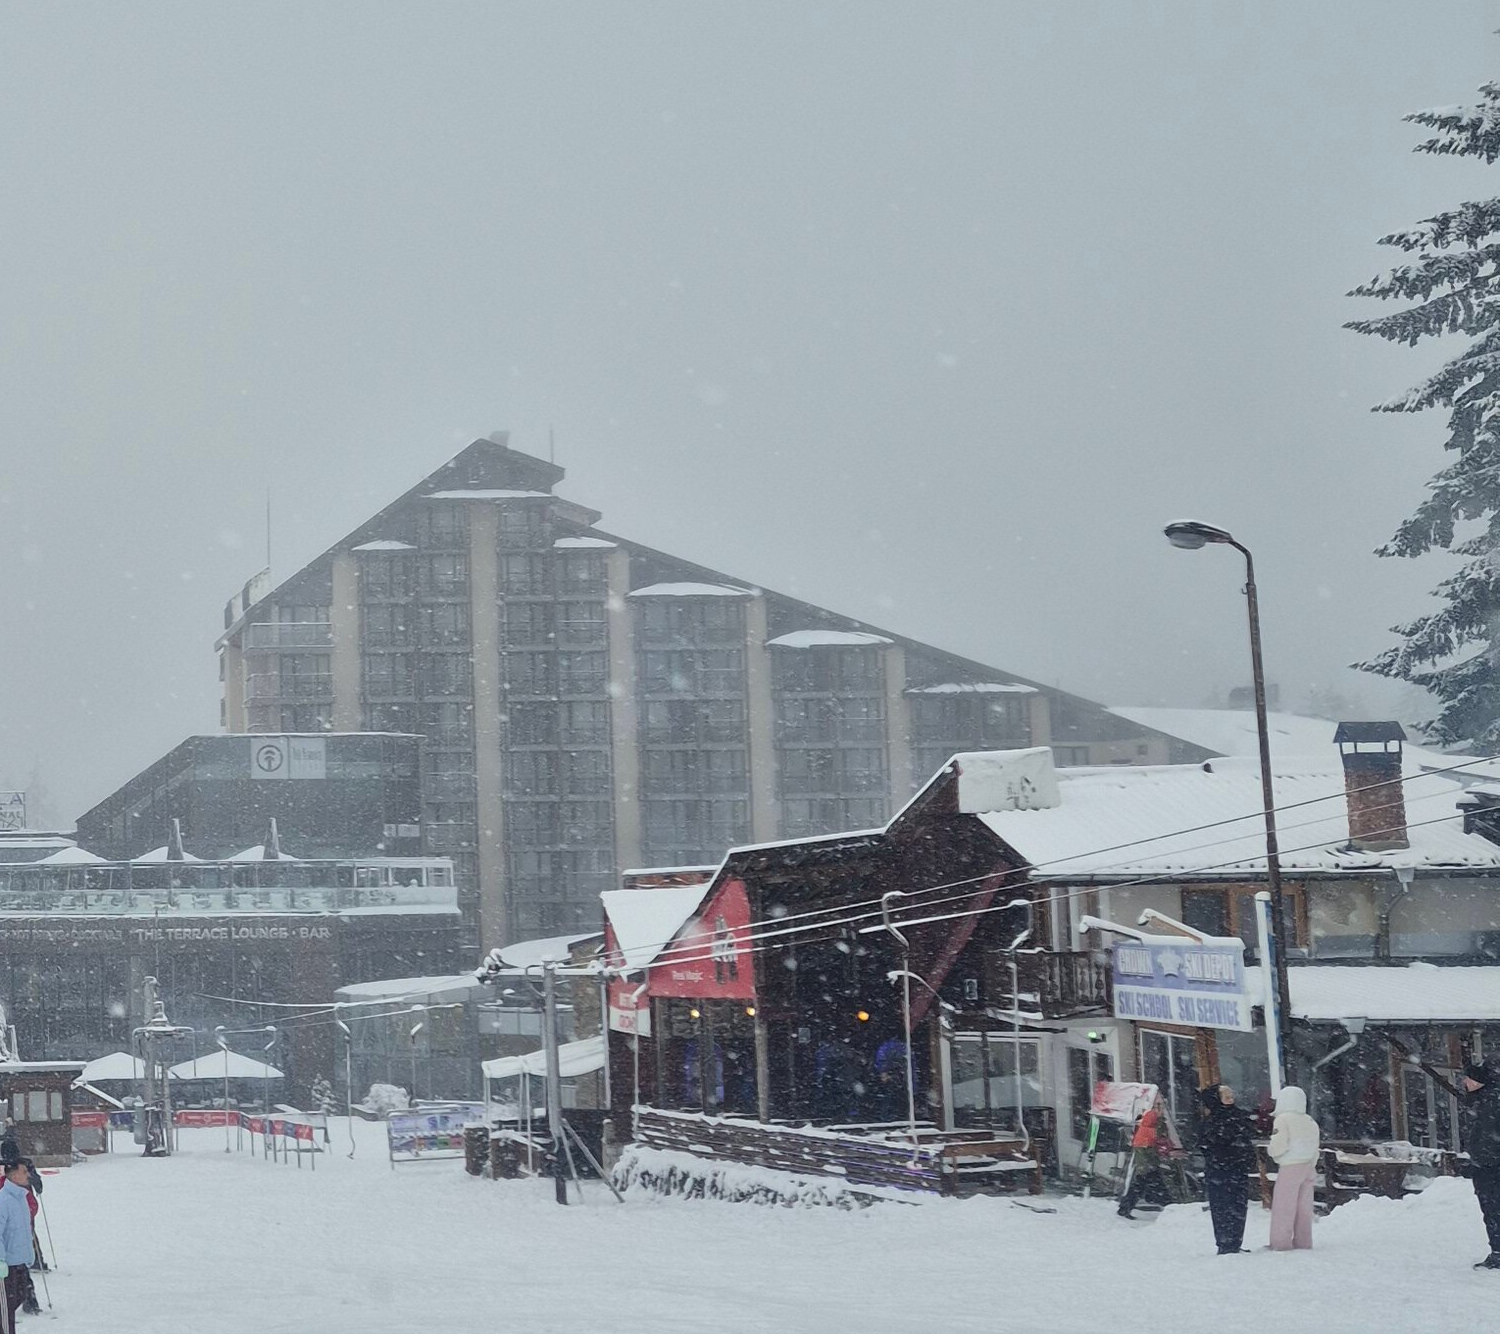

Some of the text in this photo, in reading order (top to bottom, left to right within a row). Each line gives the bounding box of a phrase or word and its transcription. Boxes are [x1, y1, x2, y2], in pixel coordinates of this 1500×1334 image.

[166, 928, 228, 940] TERRACE
[231, 928, 288, 939] LOUNGE
[300, 927, 330, 938] BAR
[1118, 990, 1240, 1026] SKI SCHOOL SKI SERVICE
